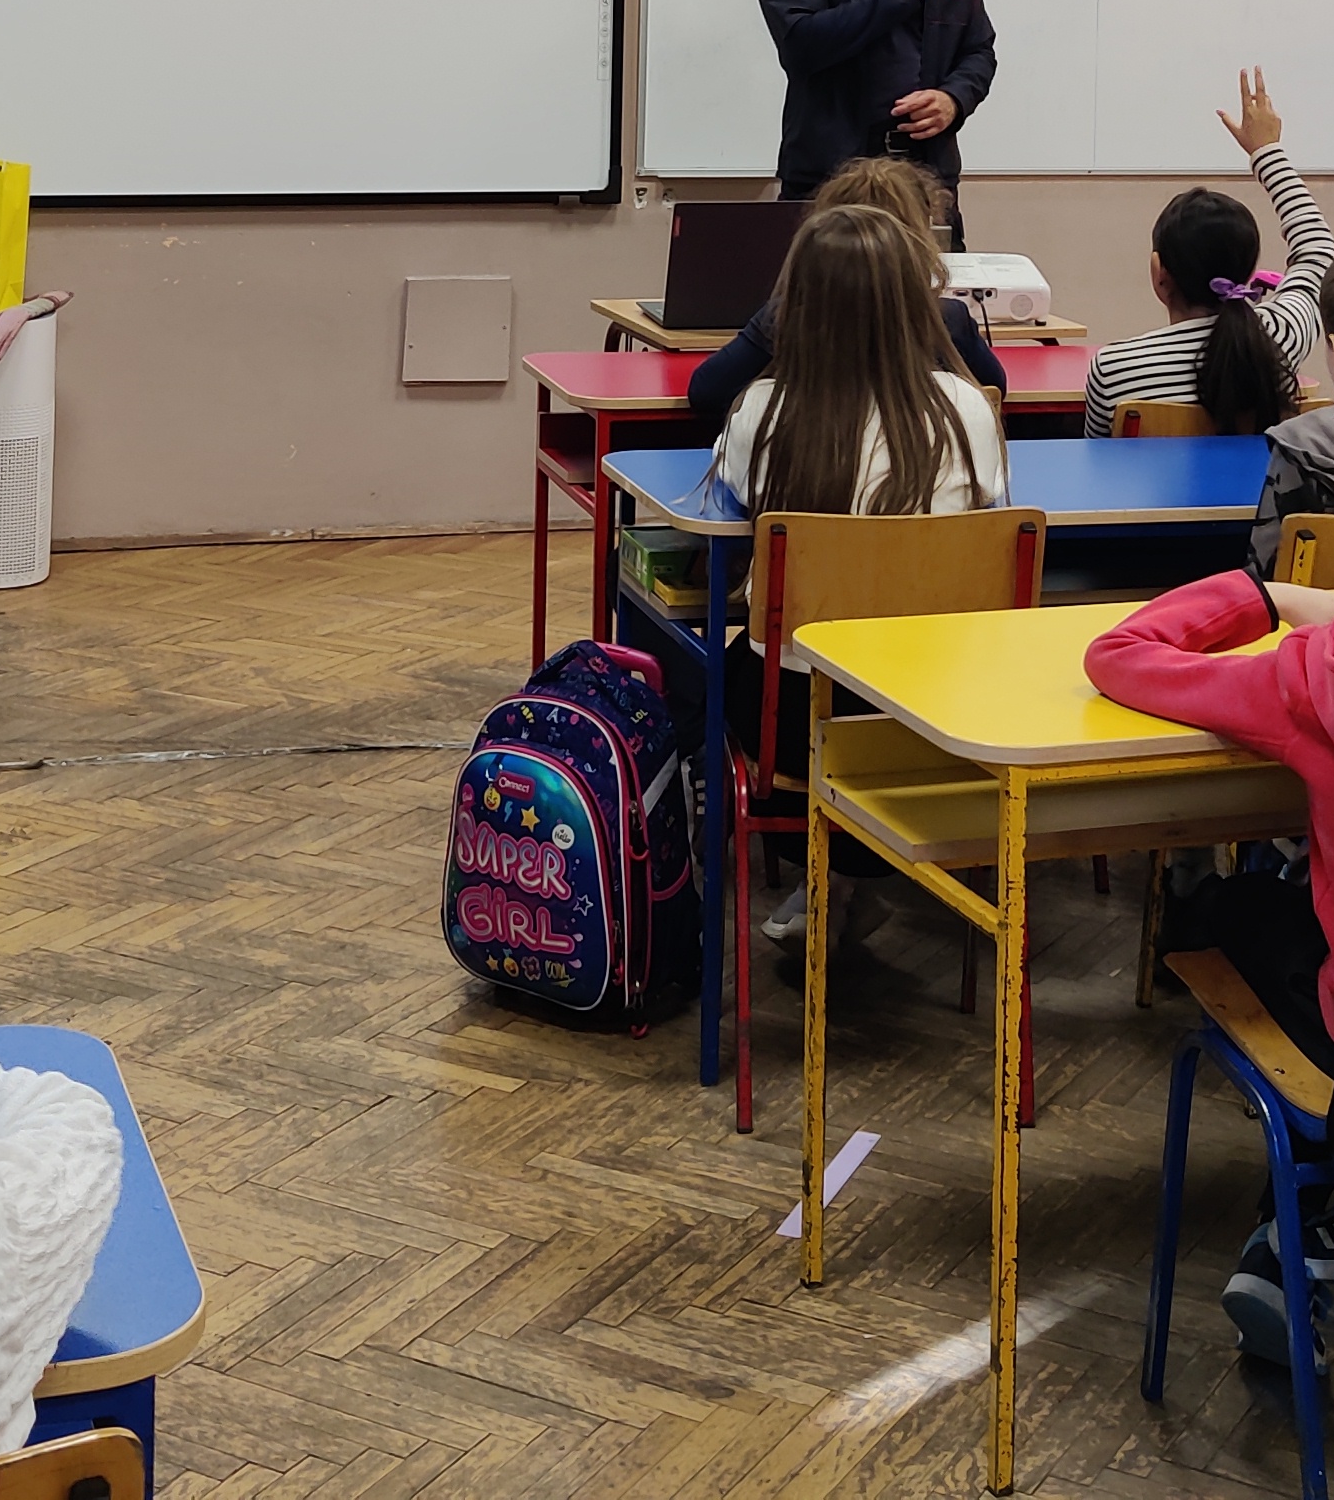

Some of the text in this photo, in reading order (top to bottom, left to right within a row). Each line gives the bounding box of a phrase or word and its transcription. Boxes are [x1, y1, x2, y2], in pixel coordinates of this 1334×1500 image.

[629, 708, 649, 725] LOL
[498, 776, 530, 793] Connect
[456, 811, 569, 898] SUPER
[458, 885, 574, 952] GIRL
